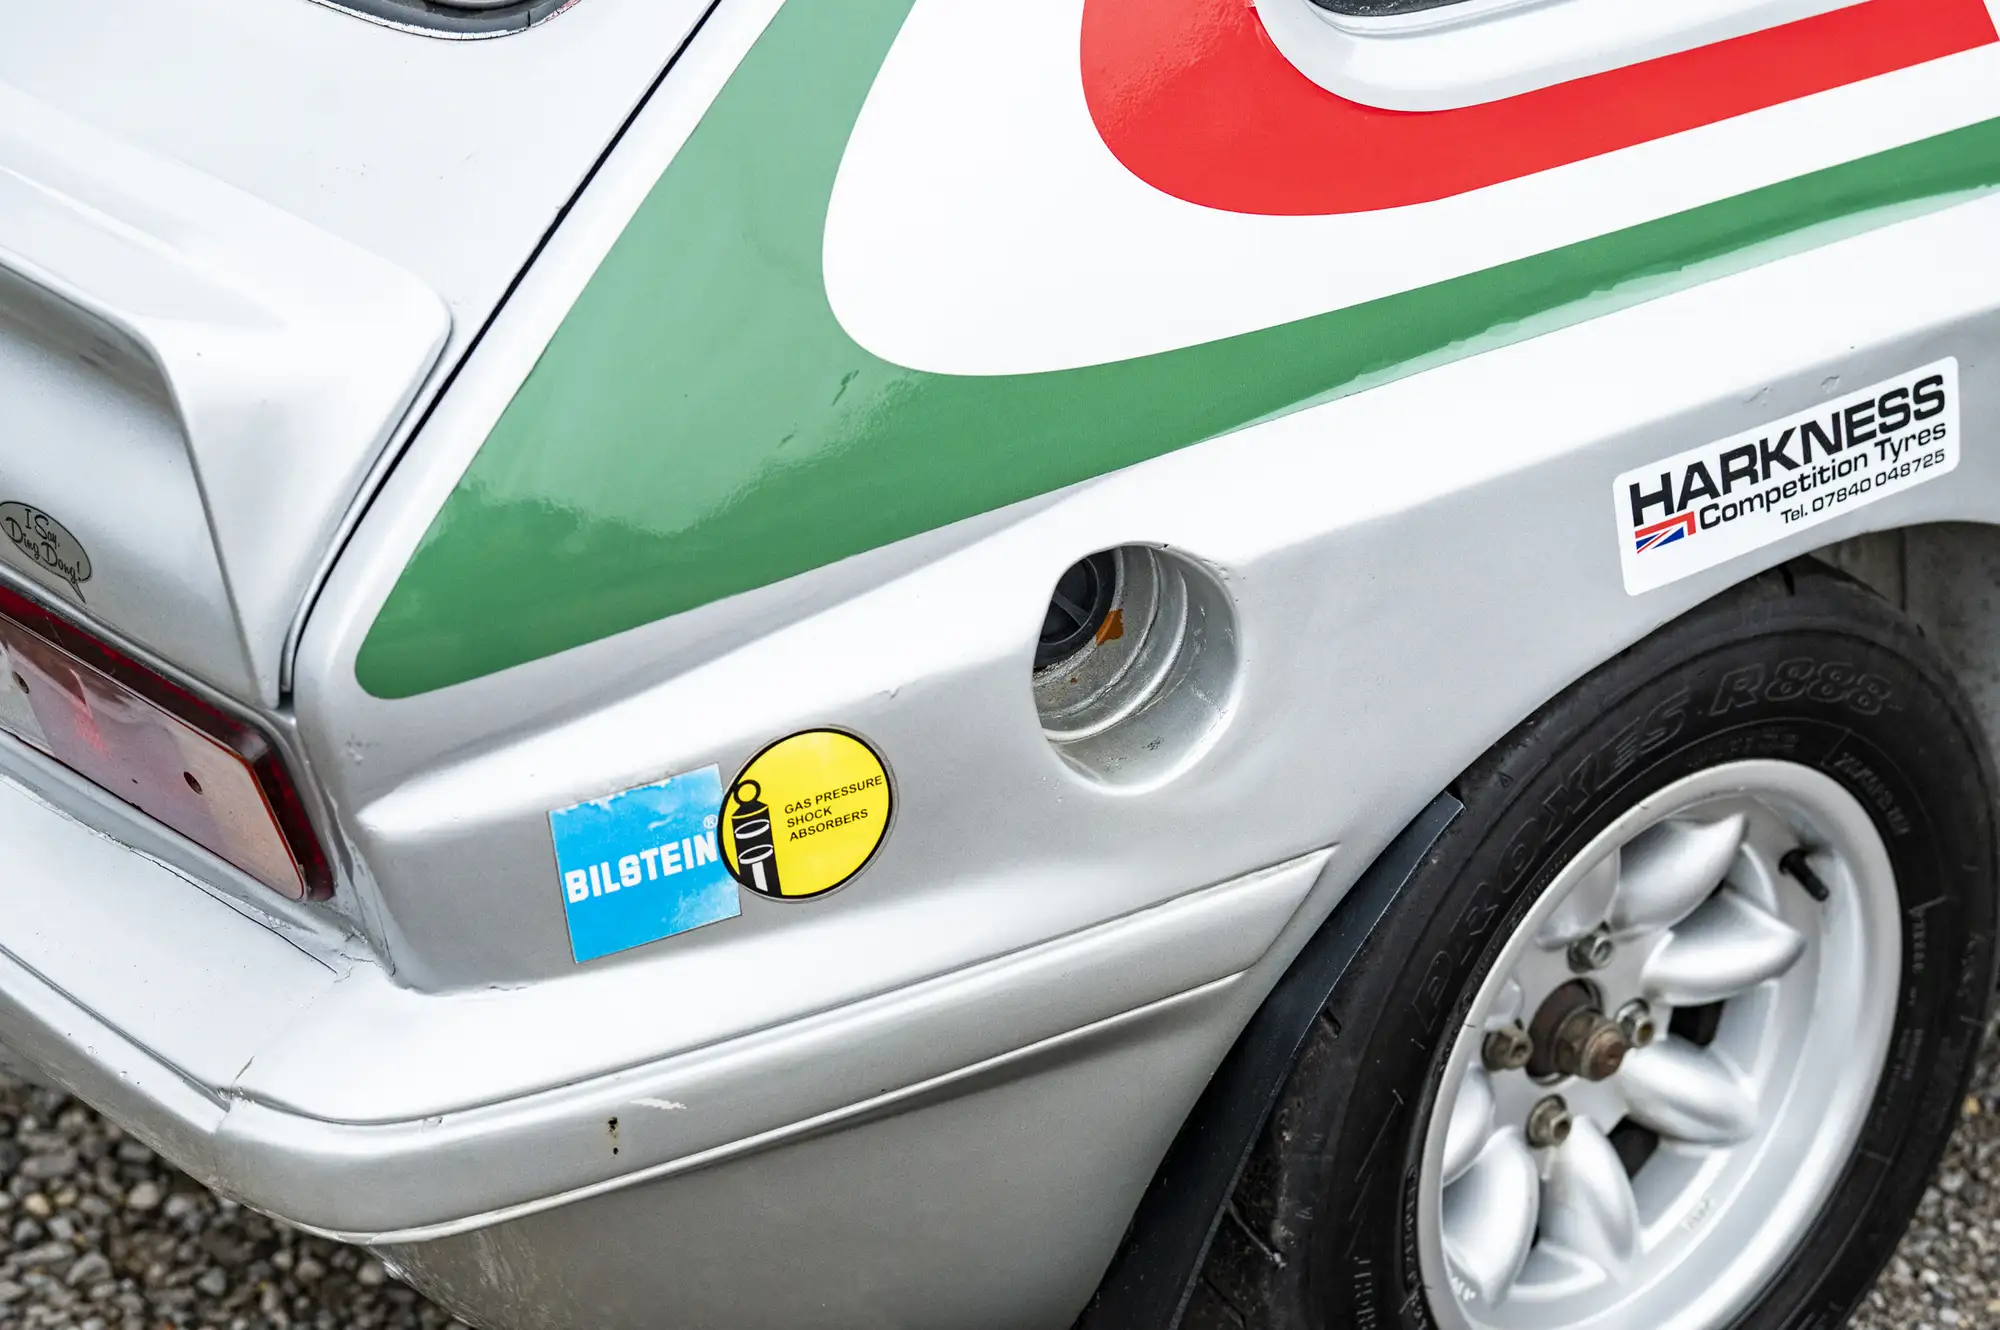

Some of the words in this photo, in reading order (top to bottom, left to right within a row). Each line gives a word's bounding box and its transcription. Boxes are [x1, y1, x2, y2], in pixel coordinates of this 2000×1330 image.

[1629, 374, 1946, 527] HARKNESS
[1700, 451, 1868, 530] Competition
[1874, 423, 1947, 465] Tyres
[24, 508, 32, 529] I
[1781, 505, 1808, 524] Tel.
[1811, 478, 1871, 512] 07840
[1875, 449, 1945, 488] 048725
[5, 517, 40, 560] Ding
[41, 541, 81, 584] Dong!
[784, 798, 812, 815] GAS
[815, 775, 883, 805] PRESSURE
[787, 806, 833, 828] SHOCK
[789, 808, 869, 842] ABSORBERS
[564, 831, 718, 904] BILSTEIN
[1411, 685, 1690, 1033] PROXES
[1708, 657, 1892, 716] R888
